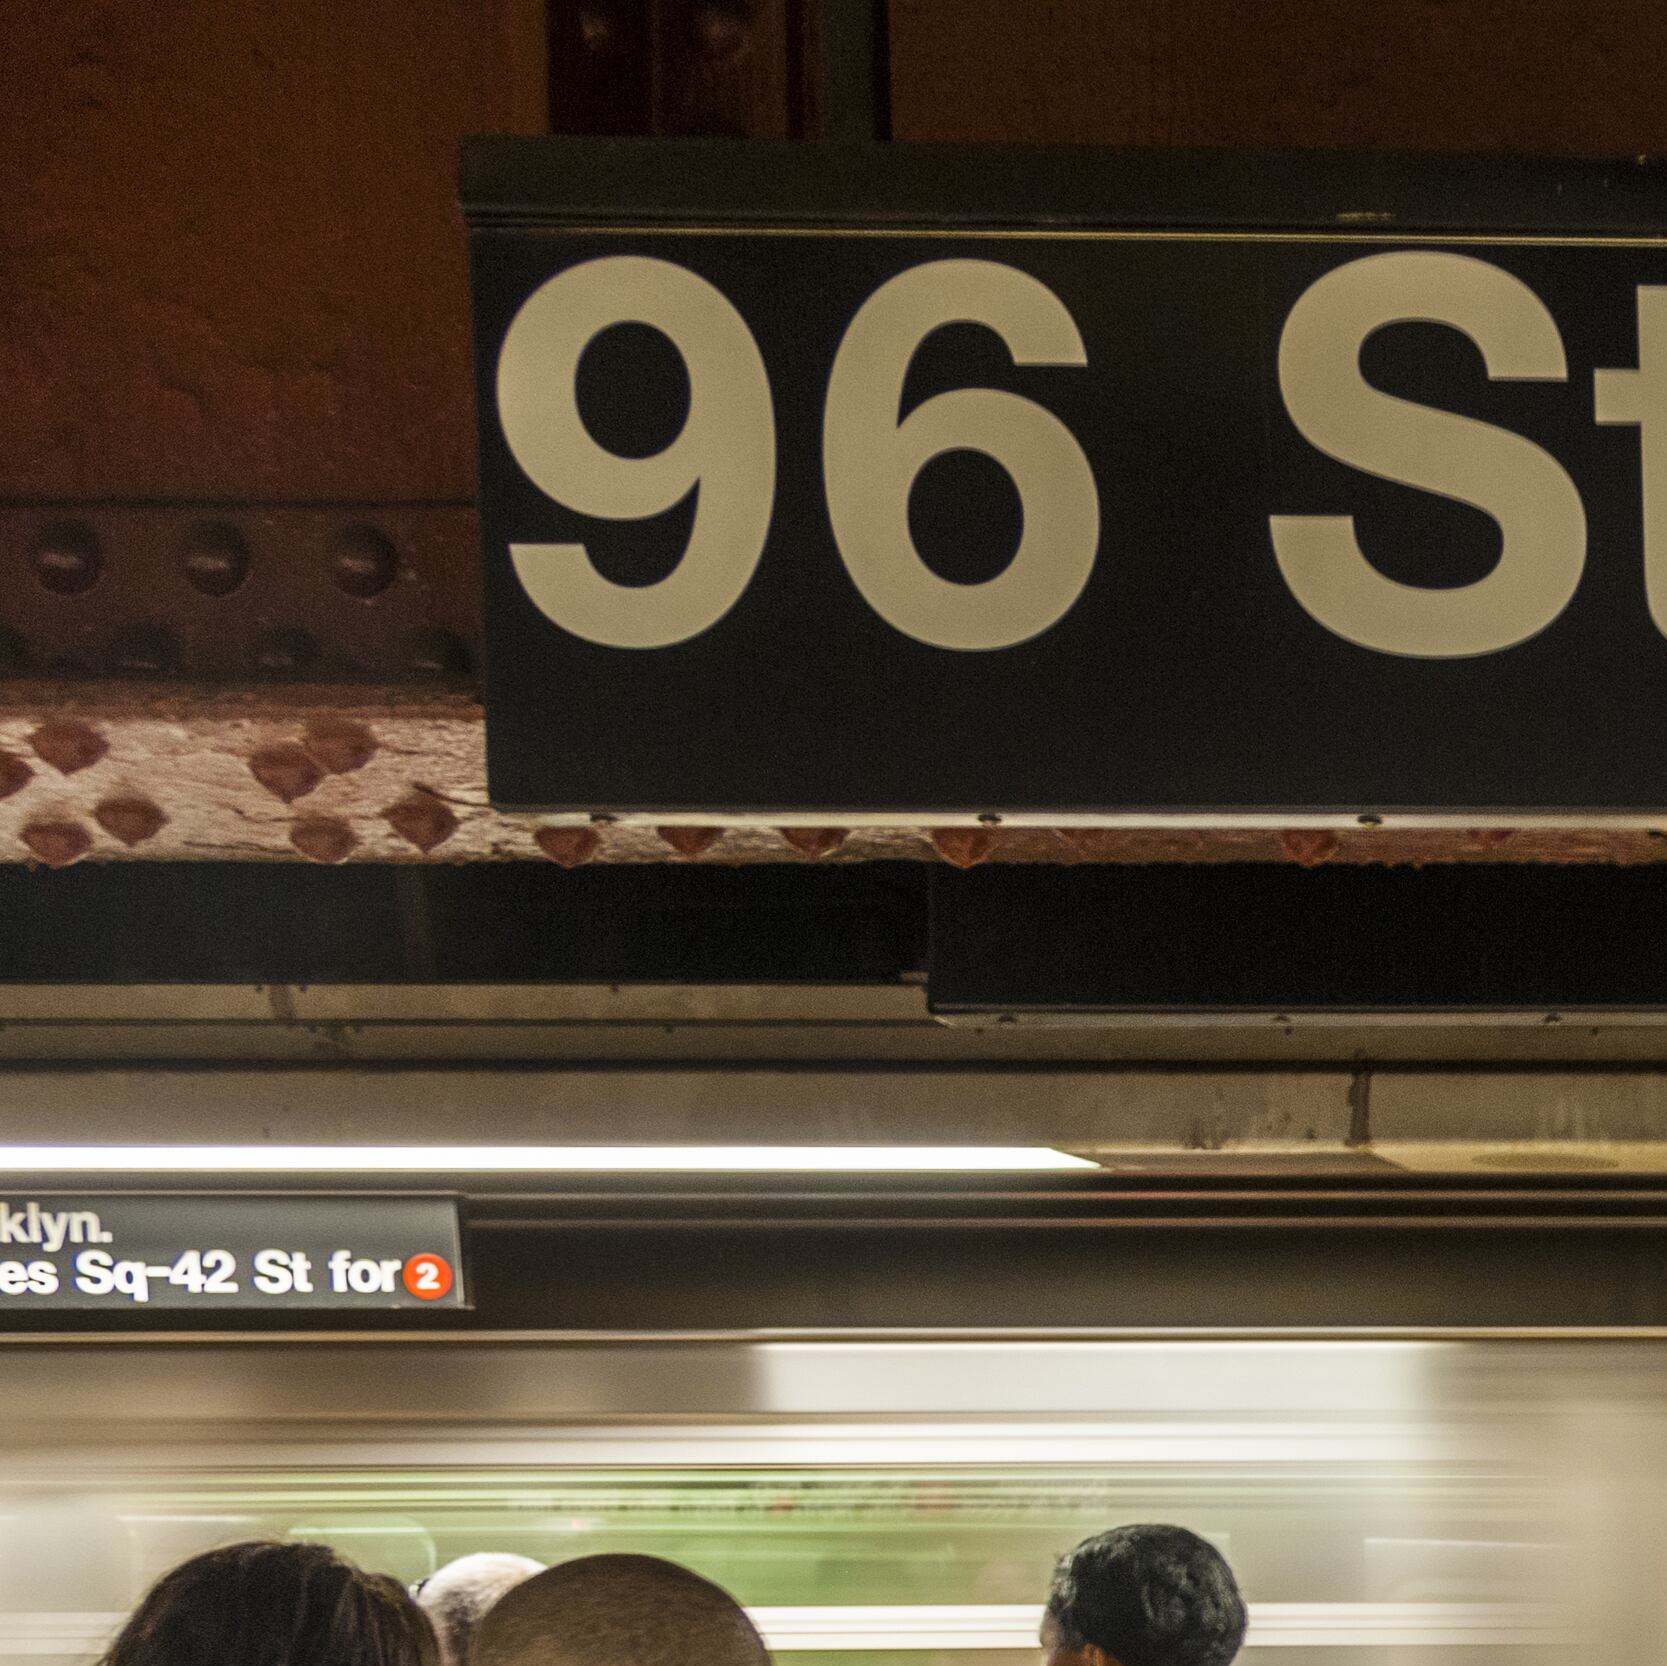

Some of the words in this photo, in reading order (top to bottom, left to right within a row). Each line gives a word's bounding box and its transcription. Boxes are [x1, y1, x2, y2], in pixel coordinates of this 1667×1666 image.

[496, 256, 1099, 650] 96
[75, 1249, 239, 1302] Sq-42
[253, 1249, 314, 1294] St
[328, 1250, 402, 1293] for
[416, 1262, 441, 1290] 2
